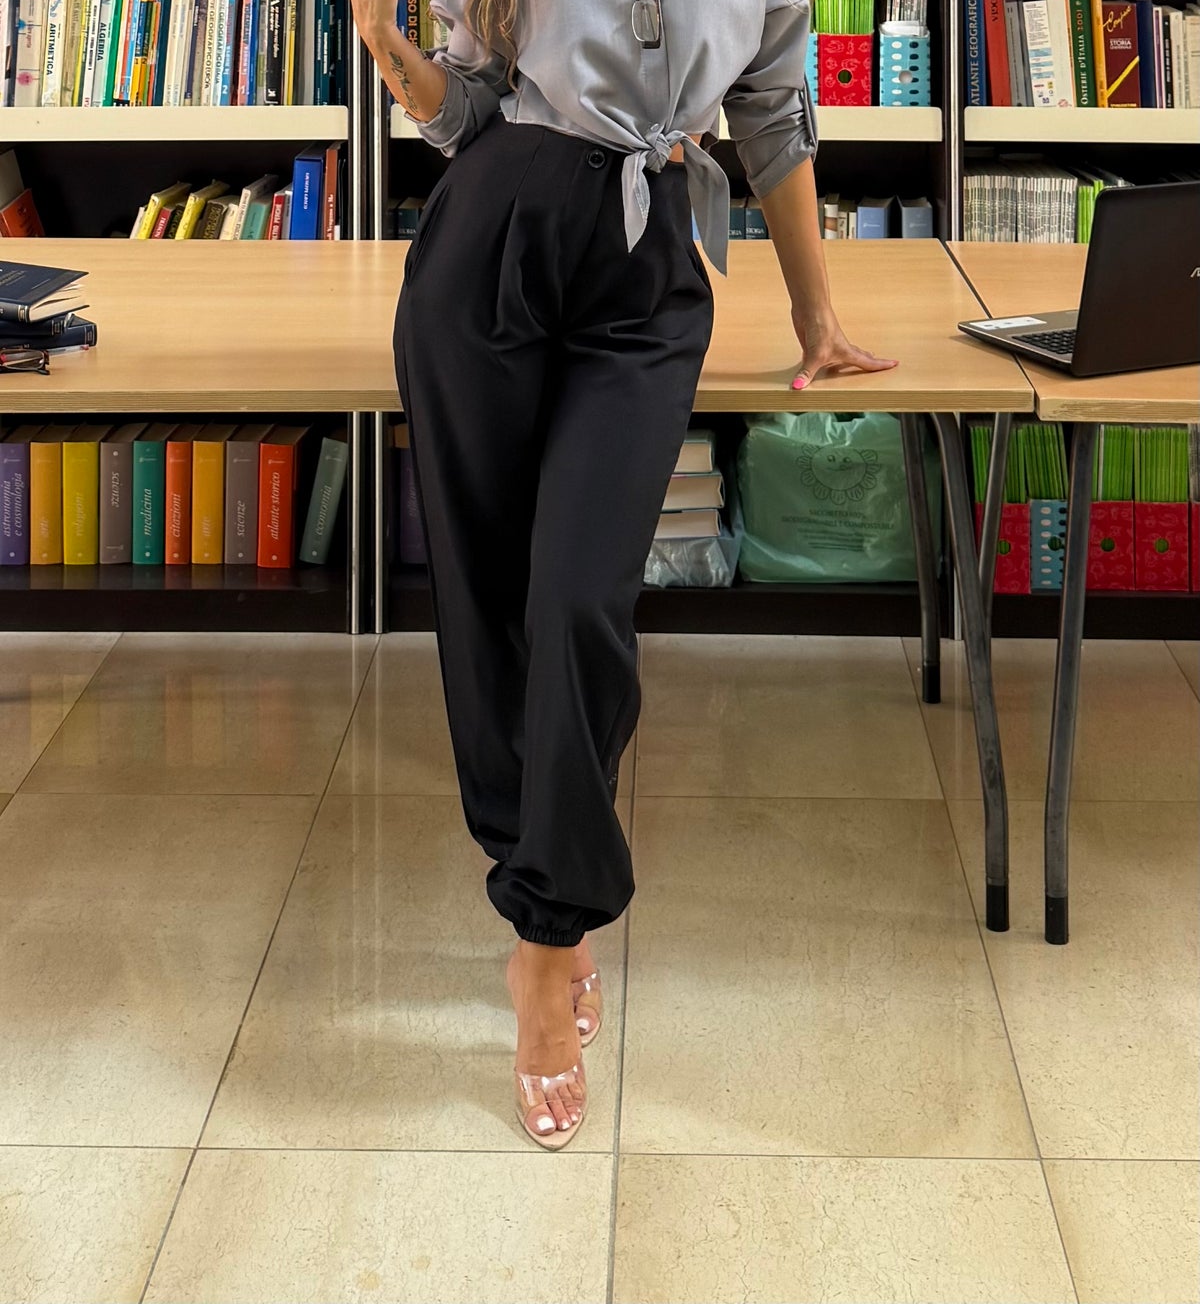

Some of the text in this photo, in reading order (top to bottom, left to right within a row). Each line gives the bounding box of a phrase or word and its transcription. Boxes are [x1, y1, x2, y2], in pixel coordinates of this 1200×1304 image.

[97, 22, 107, 61] ALGEBRA
[205, 11, 216, 67] GEOGRAFICO
[215, 12, 225, 68] GEOGRAFICO
[408, 16, 417, 26] DI
[46, 23, 57, 76] ARITMETICA
[969, 60, 980, 106] ATLANTE
[3, 480, 12, 537] astronomia
[14, 472, 24, 528] cosmologia
[111, 471, 120, 508] scienze
[143, 488, 153, 537] medicina
[268, 471, 281, 541] atlante storico
[236, 499, 246, 537] scienze
